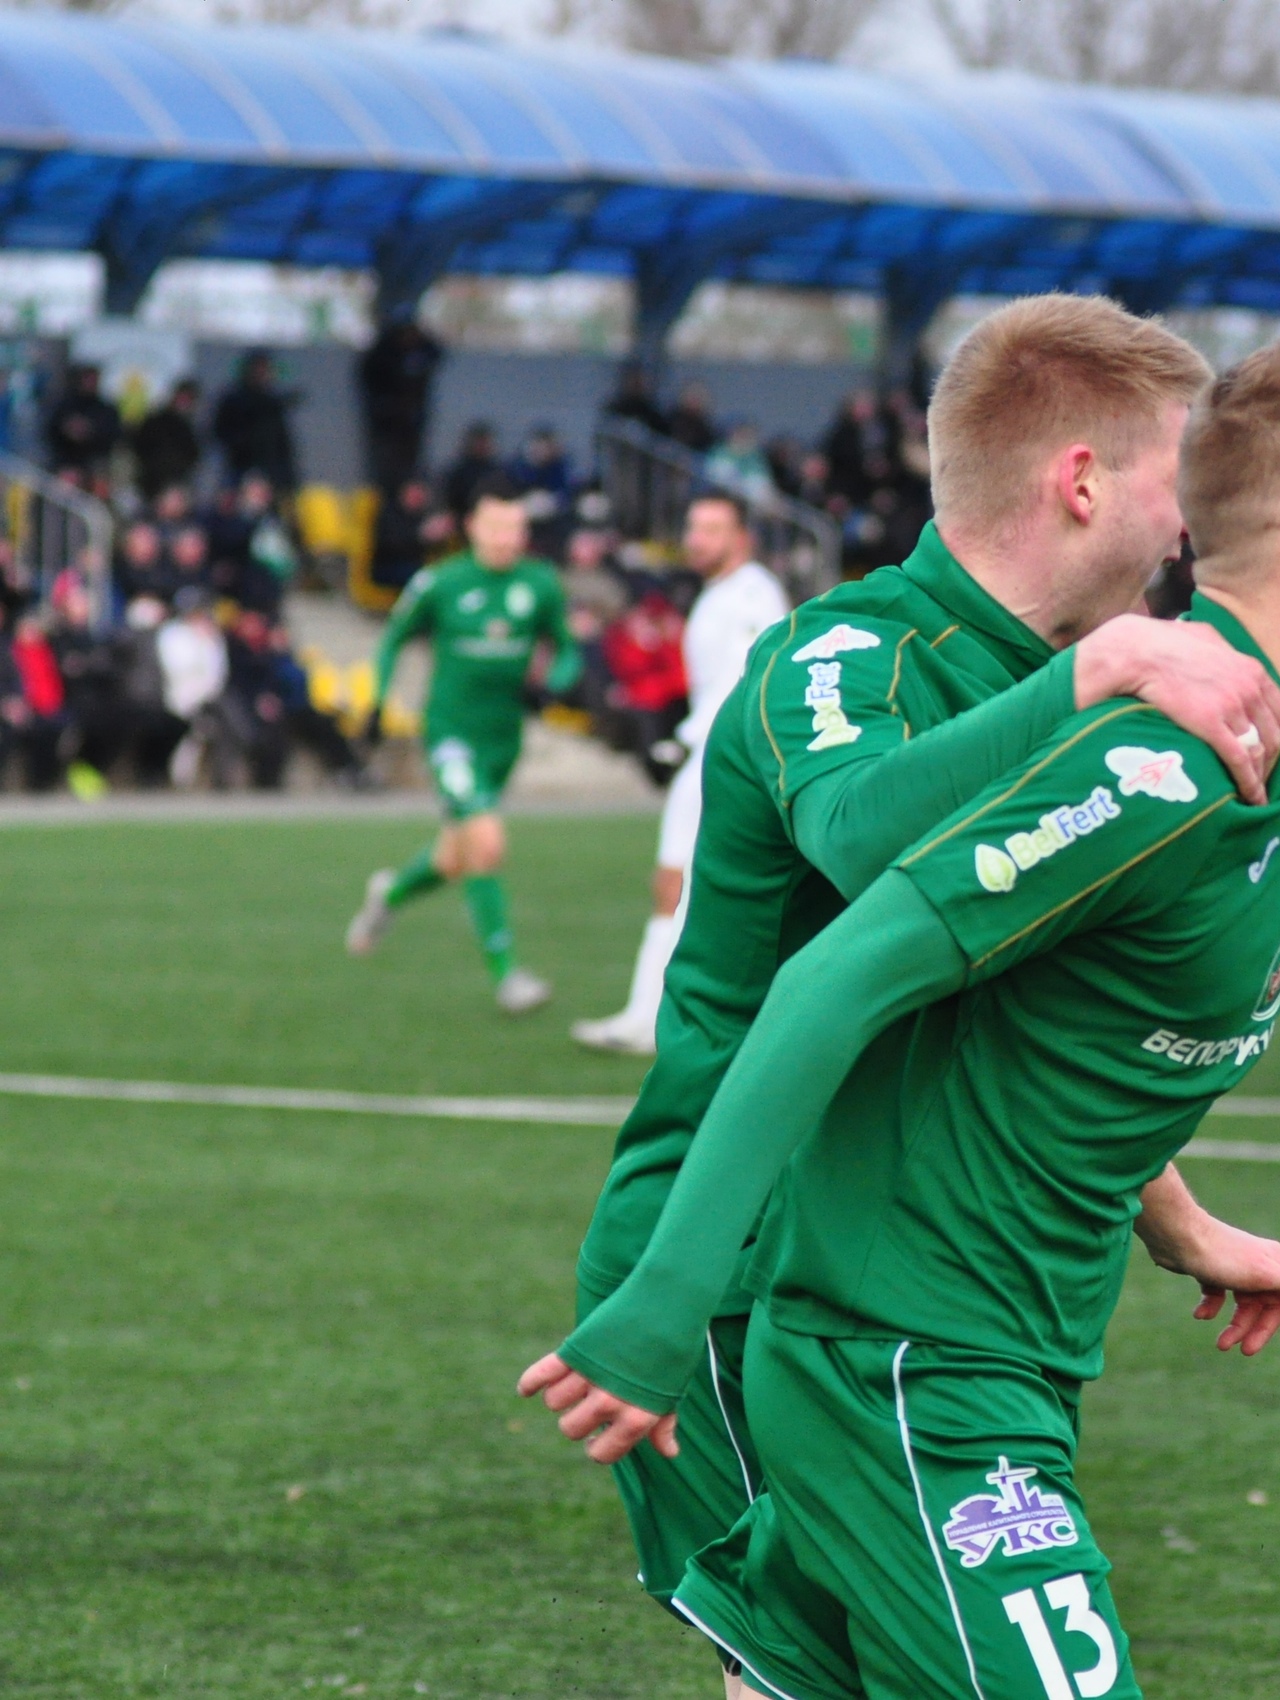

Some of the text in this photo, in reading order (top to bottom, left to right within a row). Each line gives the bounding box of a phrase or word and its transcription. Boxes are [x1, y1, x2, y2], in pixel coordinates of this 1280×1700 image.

[1007, 790, 1117, 868] BelFert
[952, 1519, 1076, 1563] УКС
[1001, 1573, 1118, 1700] 13
